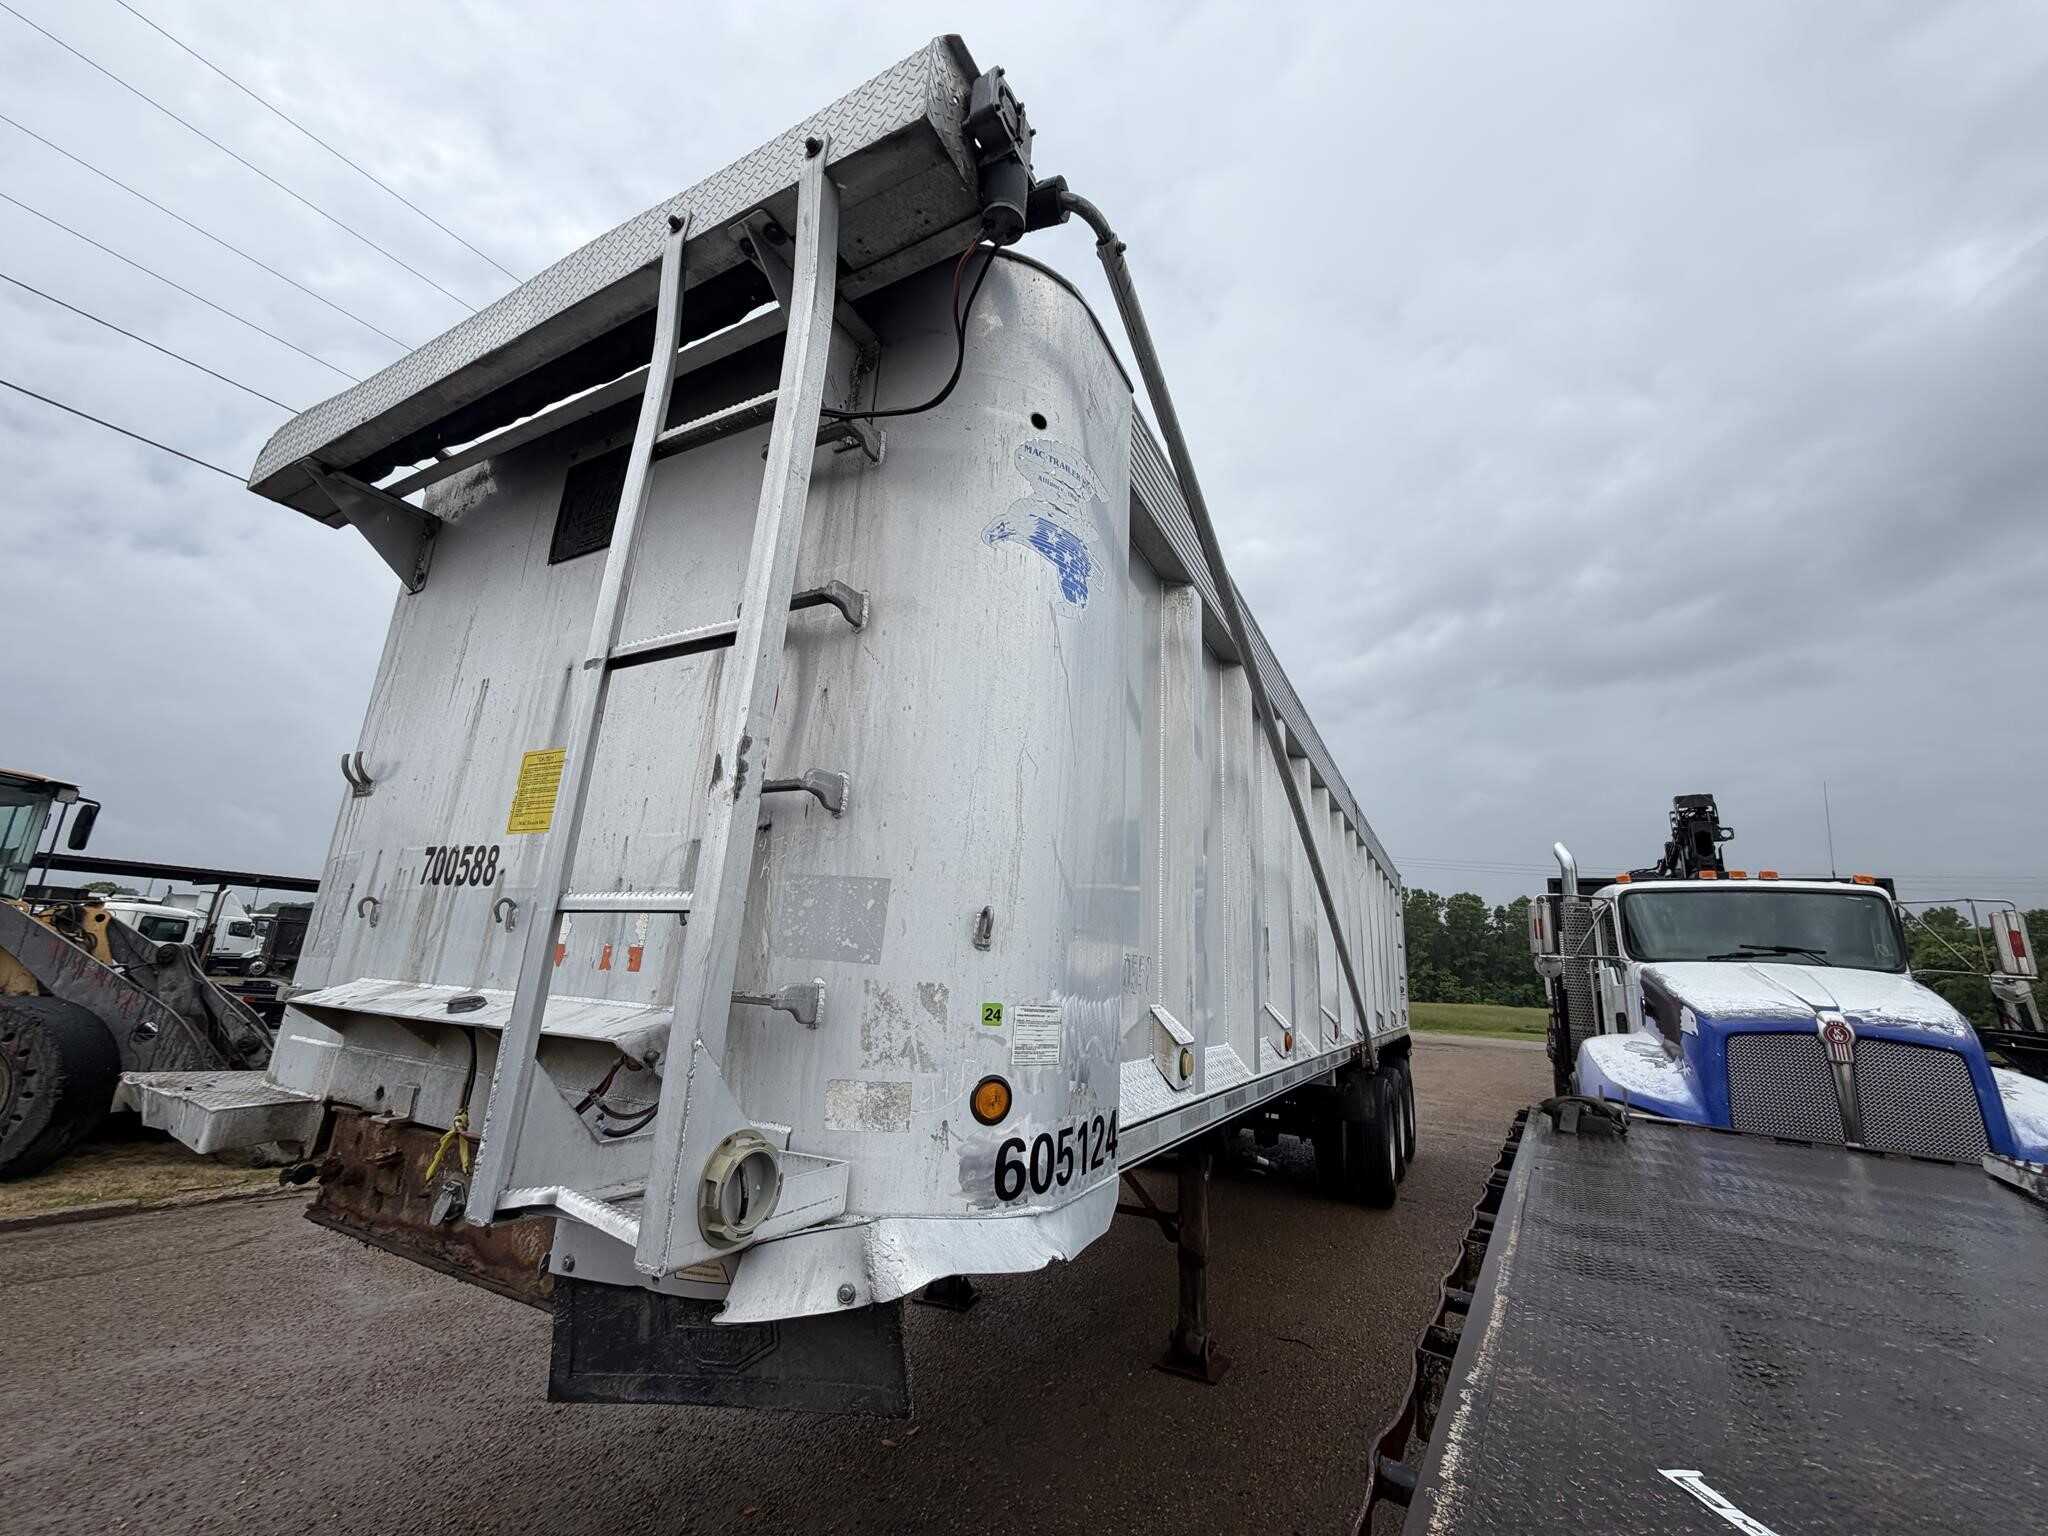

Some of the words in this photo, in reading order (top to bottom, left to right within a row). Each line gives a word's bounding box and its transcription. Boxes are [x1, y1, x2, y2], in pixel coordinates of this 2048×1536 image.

[420, 845, 500, 887] 700588
[984, 1007, 1002, 1022] 24
[994, 1109, 1118, 1202] 605124
